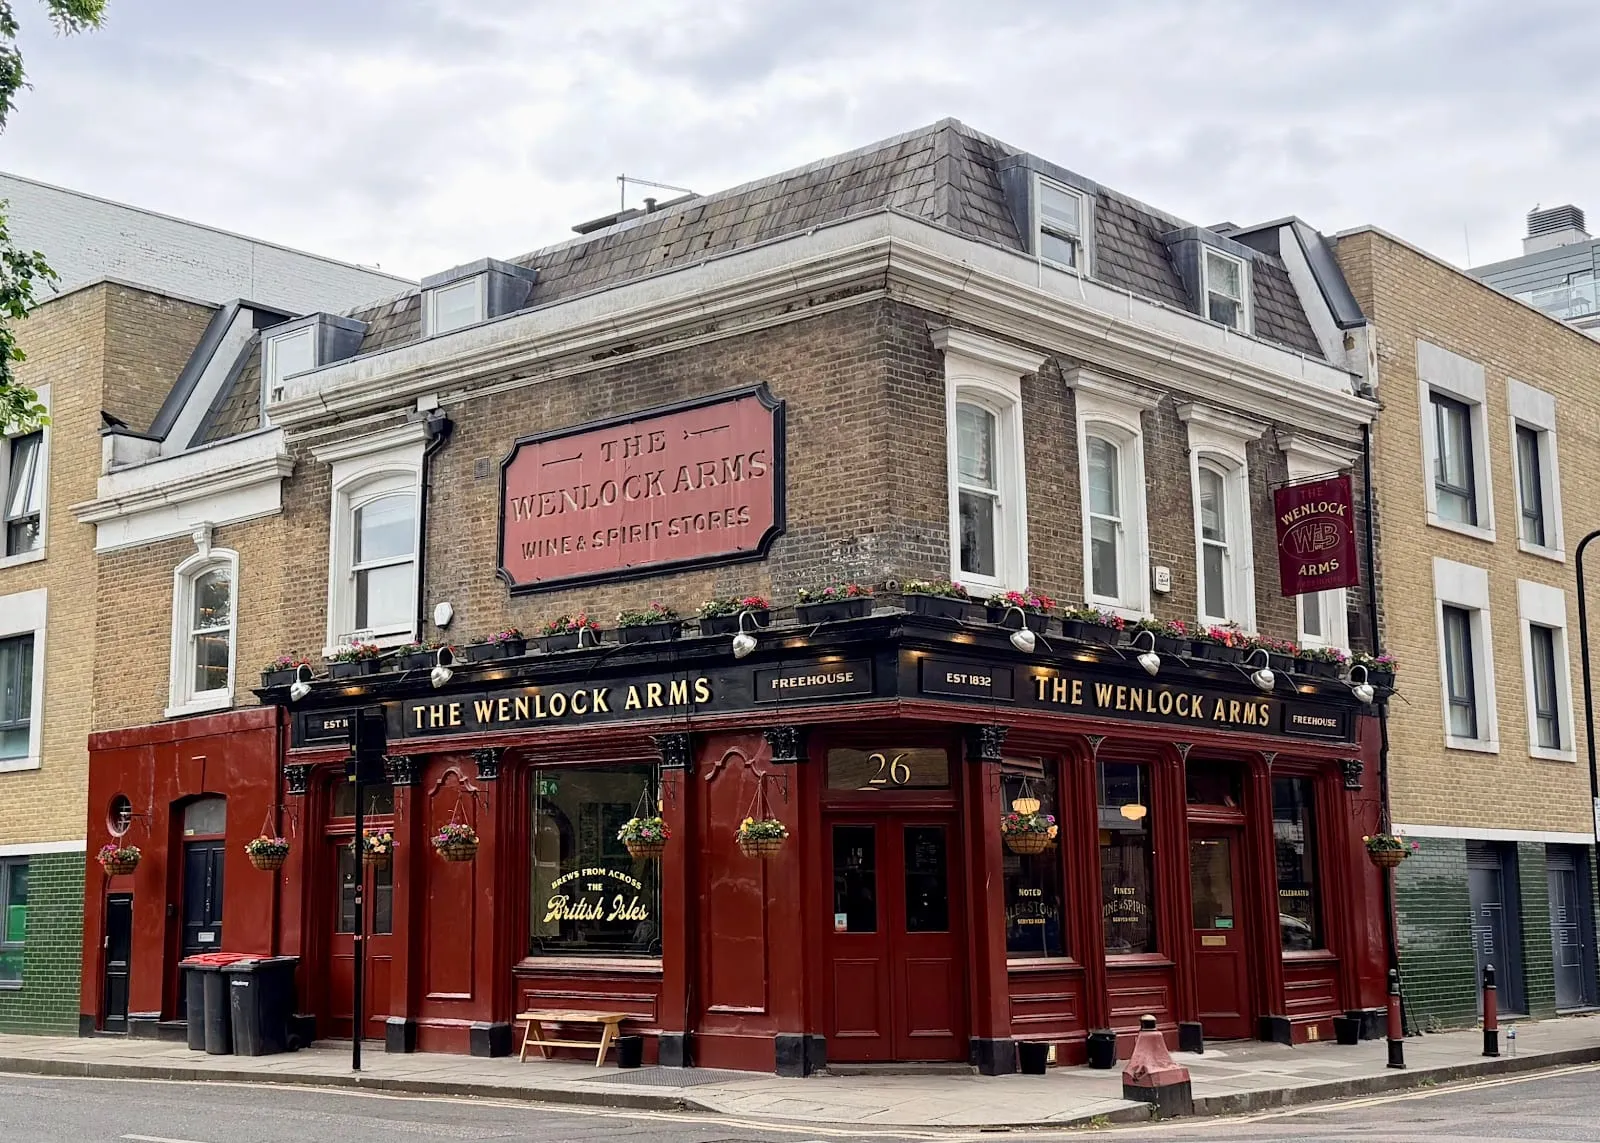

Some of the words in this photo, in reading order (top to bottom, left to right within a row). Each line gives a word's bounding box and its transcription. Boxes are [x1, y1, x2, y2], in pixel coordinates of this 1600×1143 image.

[601, 431, 666, 462] THE
[510, 470, 666, 523] WENLOCK
[672, 450, 768, 494] ARMS
[1281, 501, 1347, 525] WENLOCK
[521, 535, 573, 561] WINE
[576, 535, 587, 552] &
[591, 520, 664, 549] SPIRIT
[668, 505, 751, 536] STORES
[1298, 558, 1340, 576] ARMS
[771, 671, 855, 689] FREEHOUSE
[946, 672, 967, 684] EST
[969, 675, 992, 687] 1832
[412, 702, 462, 729] THE
[474, 687, 610, 724] WENLOCK
[624, 677, 711, 710] ARMS
[1035, 675, 1083, 705] THE
[1094, 682, 1204, 719] WENLOCK
[1213, 698, 1270, 727] ARMS
[323, 719, 342, 730] EST
[1292, 715, 1337, 727] FREEHOUSE
[868, 753, 911, 785] 26
[551, 870, 580, 890] BREWS
[581, 867, 606, 877] FROM
[608, 869, 642, 890] ACROSS
[587, 883, 603, 891] THE
[1018, 888, 1042, 896] NOTED
[1113, 887, 1135, 895] FINEST
[1279, 889, 1310, 897] CELEBRATED
[543, 894, 605, 923] British
[607, 893, 649, 922] Isles
